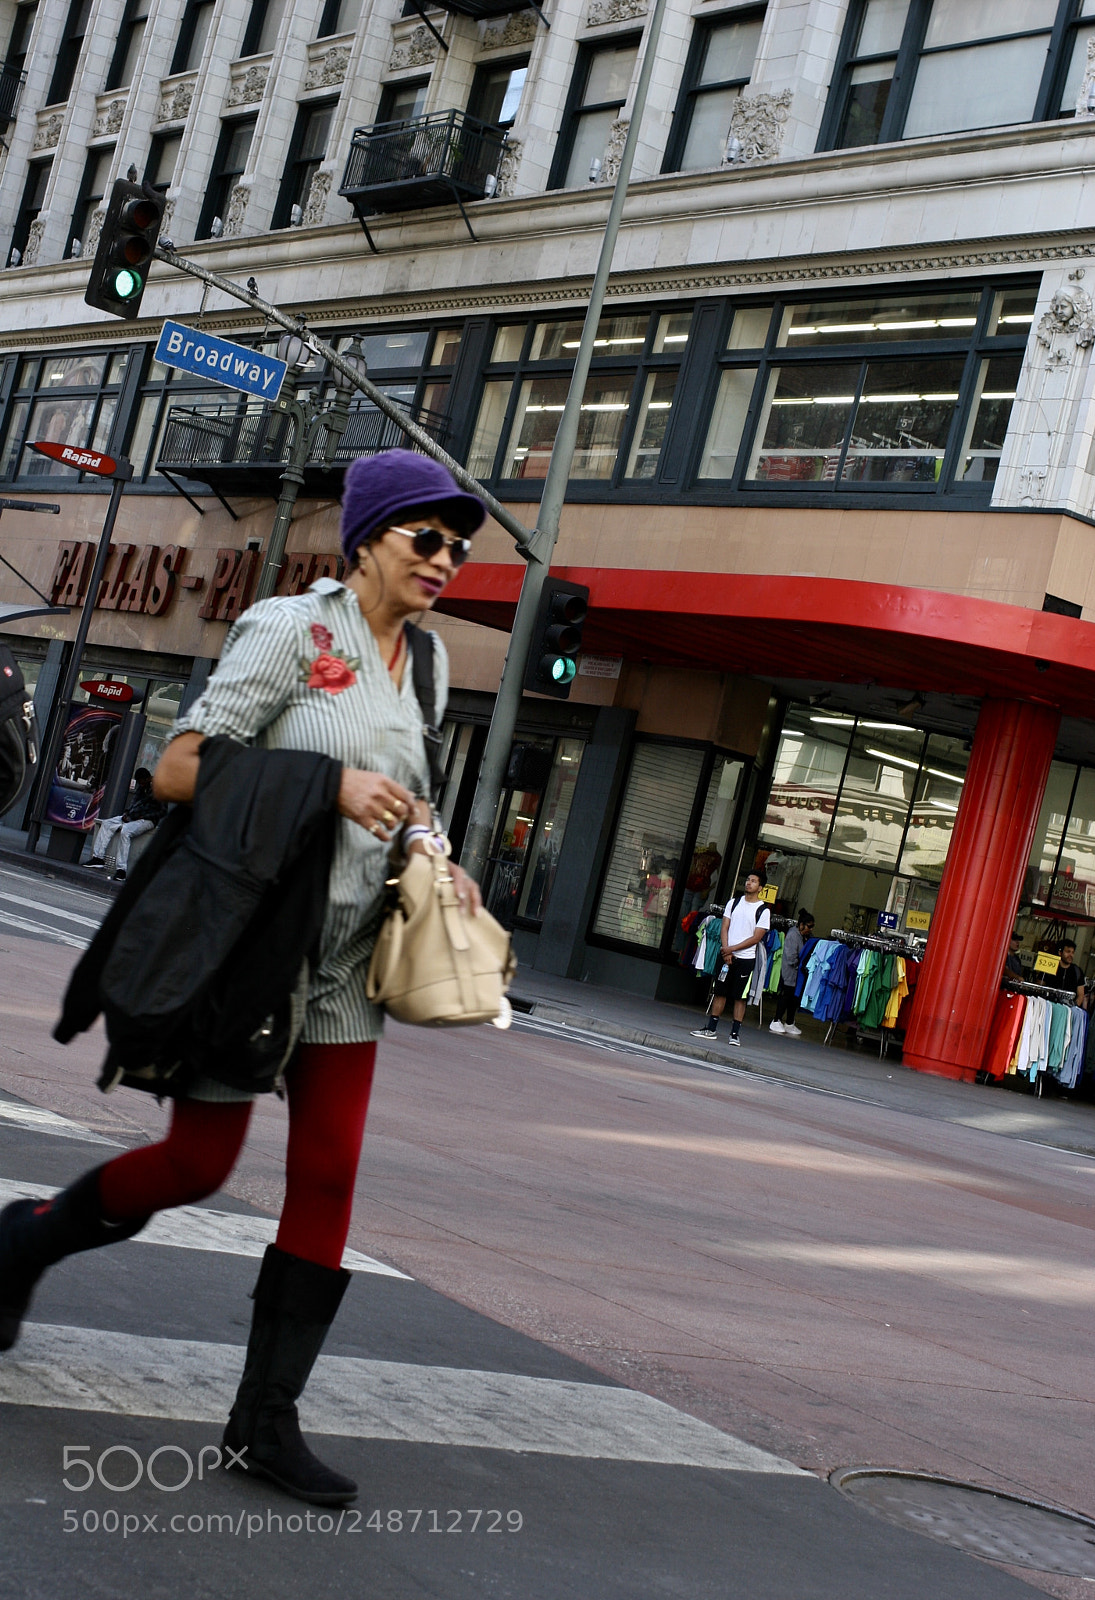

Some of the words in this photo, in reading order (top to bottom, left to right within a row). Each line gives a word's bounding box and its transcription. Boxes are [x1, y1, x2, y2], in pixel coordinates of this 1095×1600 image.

[166, 330, 276, 390] Broadway
[61, 447, 102, 468] Rapid
[50, 540, 186, 616] FALAS
[199, 548, 348, 620] PAE
[97, 684, 123, 697] Rapid
